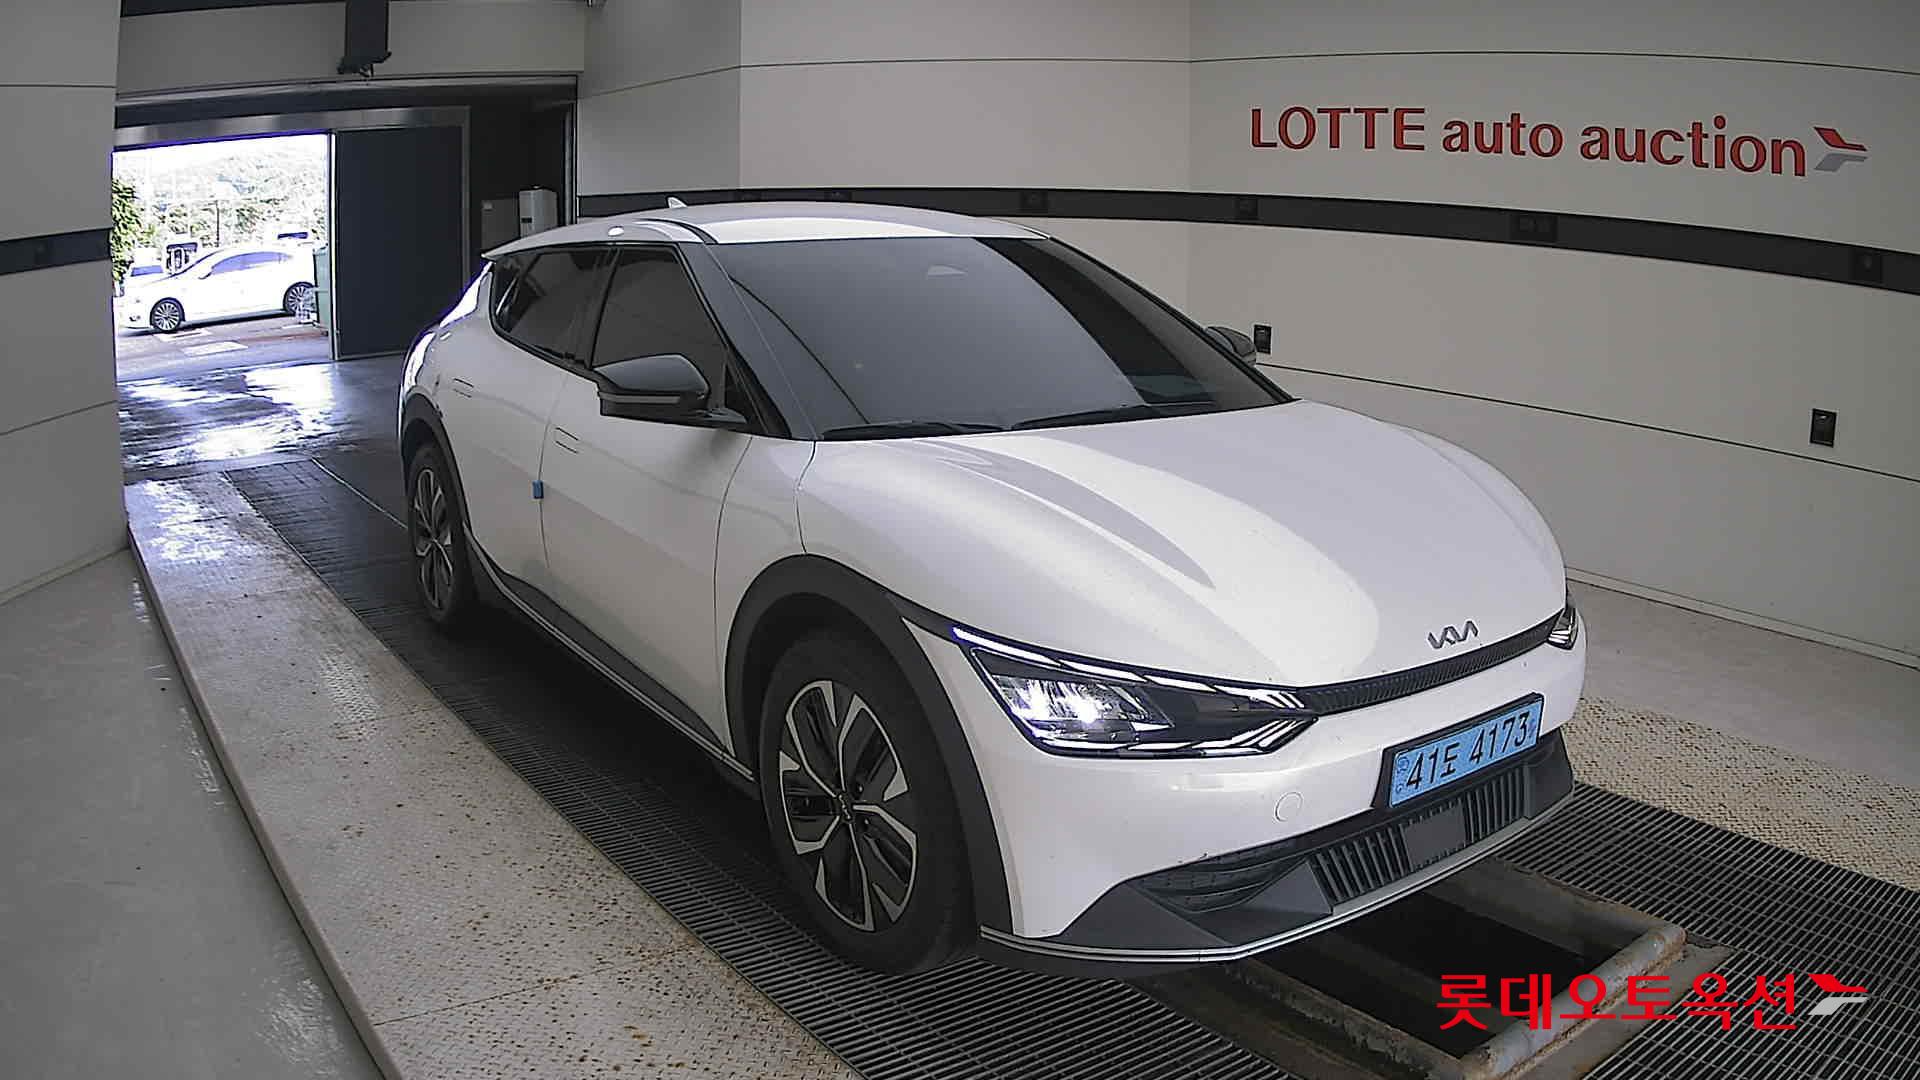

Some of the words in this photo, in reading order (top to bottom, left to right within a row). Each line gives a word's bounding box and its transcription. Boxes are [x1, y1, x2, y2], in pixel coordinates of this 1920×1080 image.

[1251, 106, 1426, 151] LOTTE
[1442, 112, 1563, 158] auto
[1580, 115, 1806, 177] auction
[1469, 711, 1530, 764] 4173
